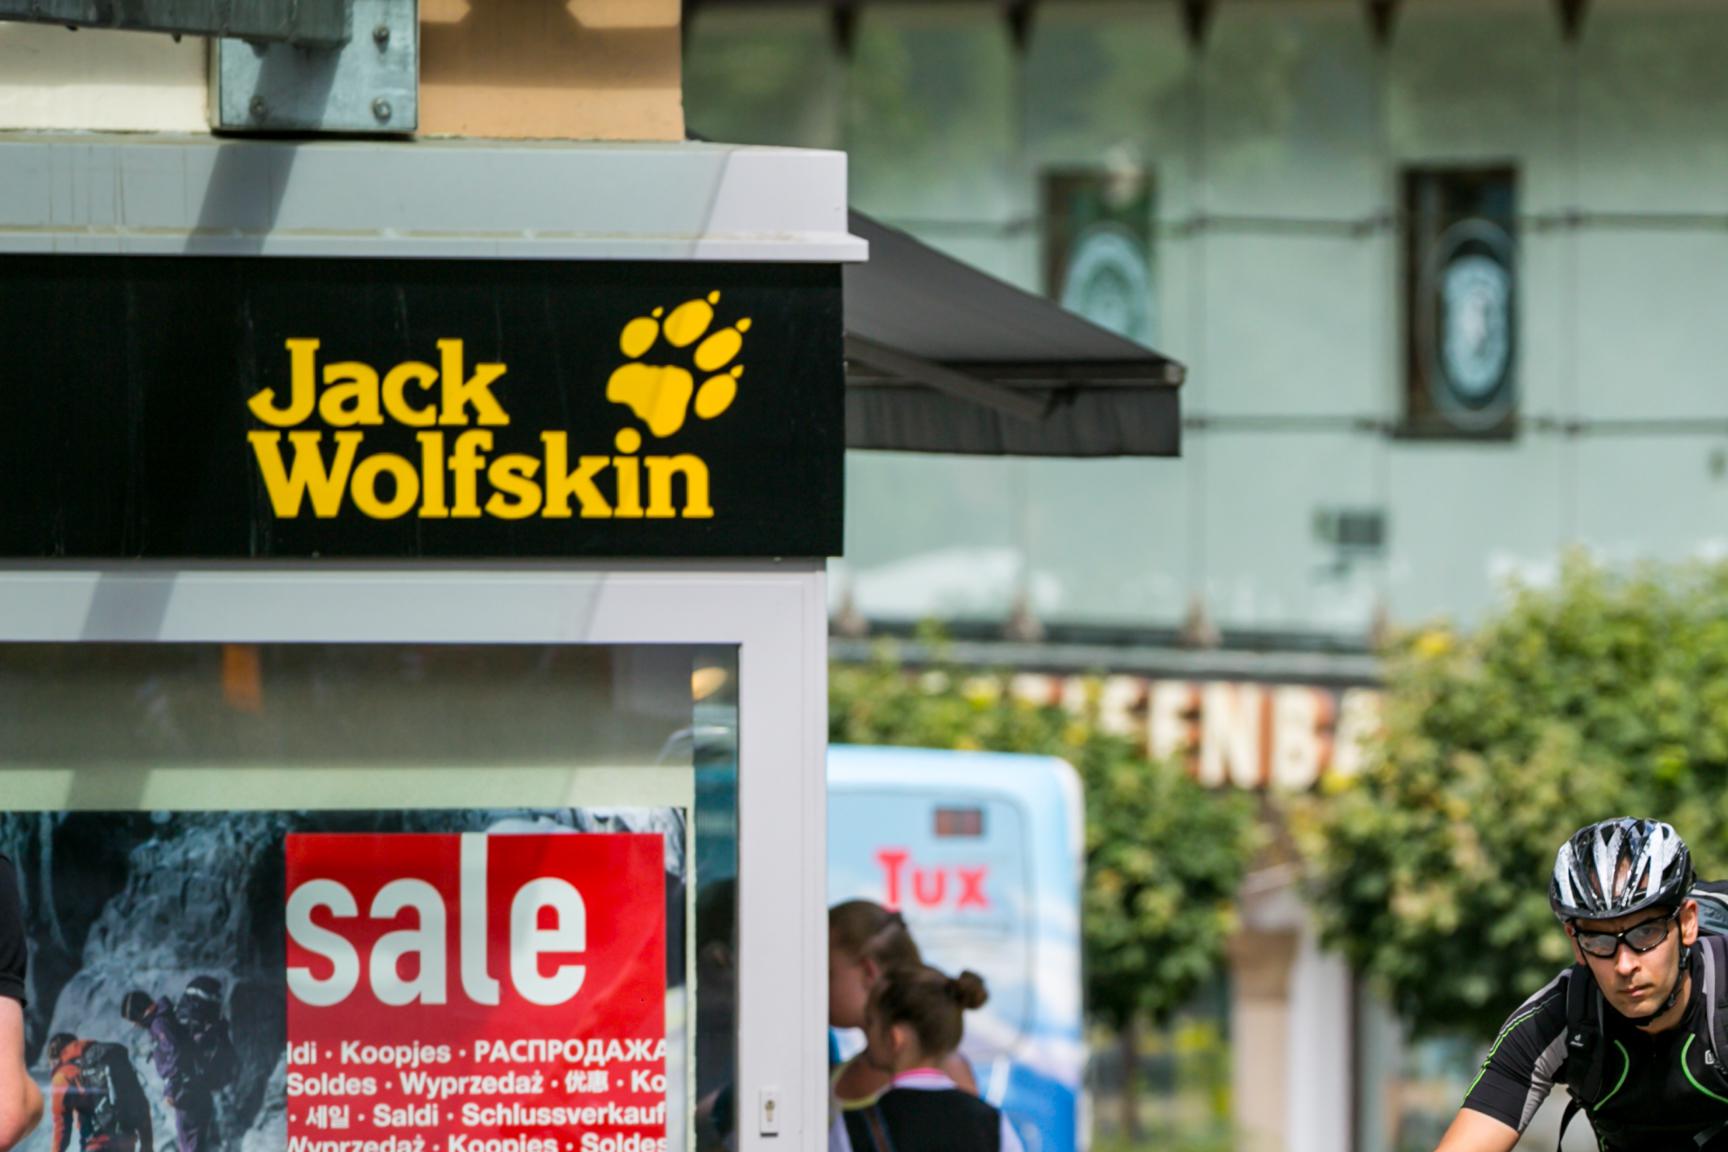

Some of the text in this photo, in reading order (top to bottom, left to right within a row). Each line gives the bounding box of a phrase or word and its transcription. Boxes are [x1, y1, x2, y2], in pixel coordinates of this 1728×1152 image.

[247, 338, 510, 427] Jack
[247, 428, 715, 519] Wolfskin
[286, 832, 587, 1007] sale
[341, 1040, 451, 1068] Koopjes
[287, 1071, 544, 1099] Soldes Wyprzedaż
[631, 1069, 667, 1093] Ko
[305, 1104, 350, 1130] 세일
[373, 1100, 667, 1128] Saldi Schlussverkauf
